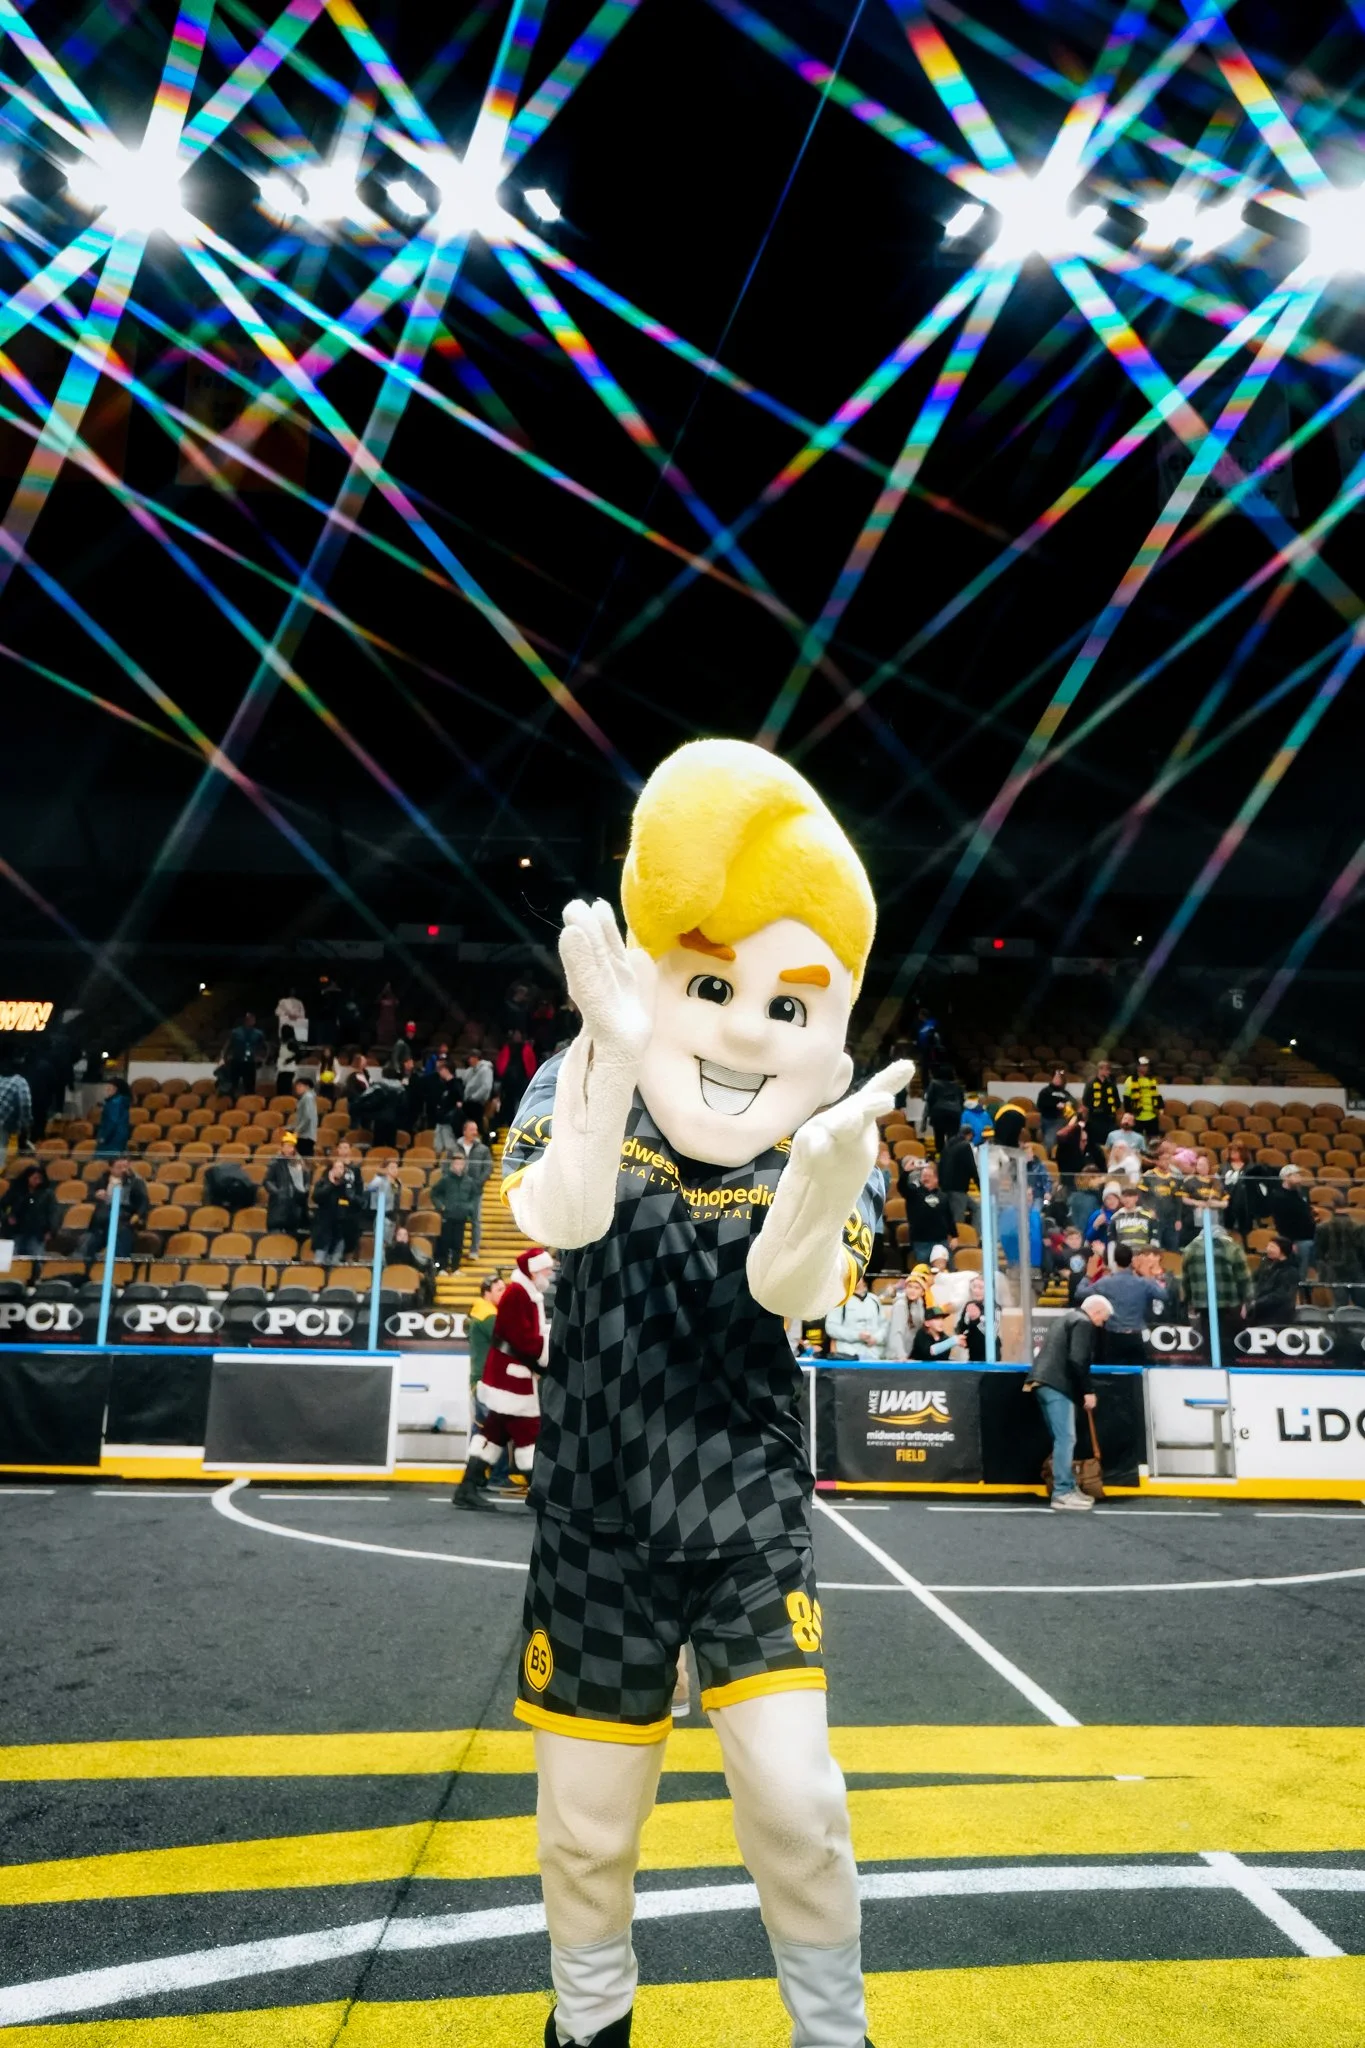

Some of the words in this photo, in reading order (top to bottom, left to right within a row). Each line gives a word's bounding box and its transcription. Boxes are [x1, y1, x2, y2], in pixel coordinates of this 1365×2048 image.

[621, 1137, 680, 1181] dwest
[682, 1184, 776, 1208] rthopedic
[620, 1162, 679, 1191] CIALTY
[688, 1208, 752, 1220] SPITAL
[0, 1302, 74, 1331] PCI
[134, 1304, 215, 1333] PCI
[264, 1307, 345, 1336] PCI
[395, 1311, 469, 1338] PCI
[1246, 1327, 1326, 1355] PCI
[879, 1389, 949, 1414] WAVE
[896, 1449, 926, 1462] FIELD
[530, 1645, 547, 1676] BS
